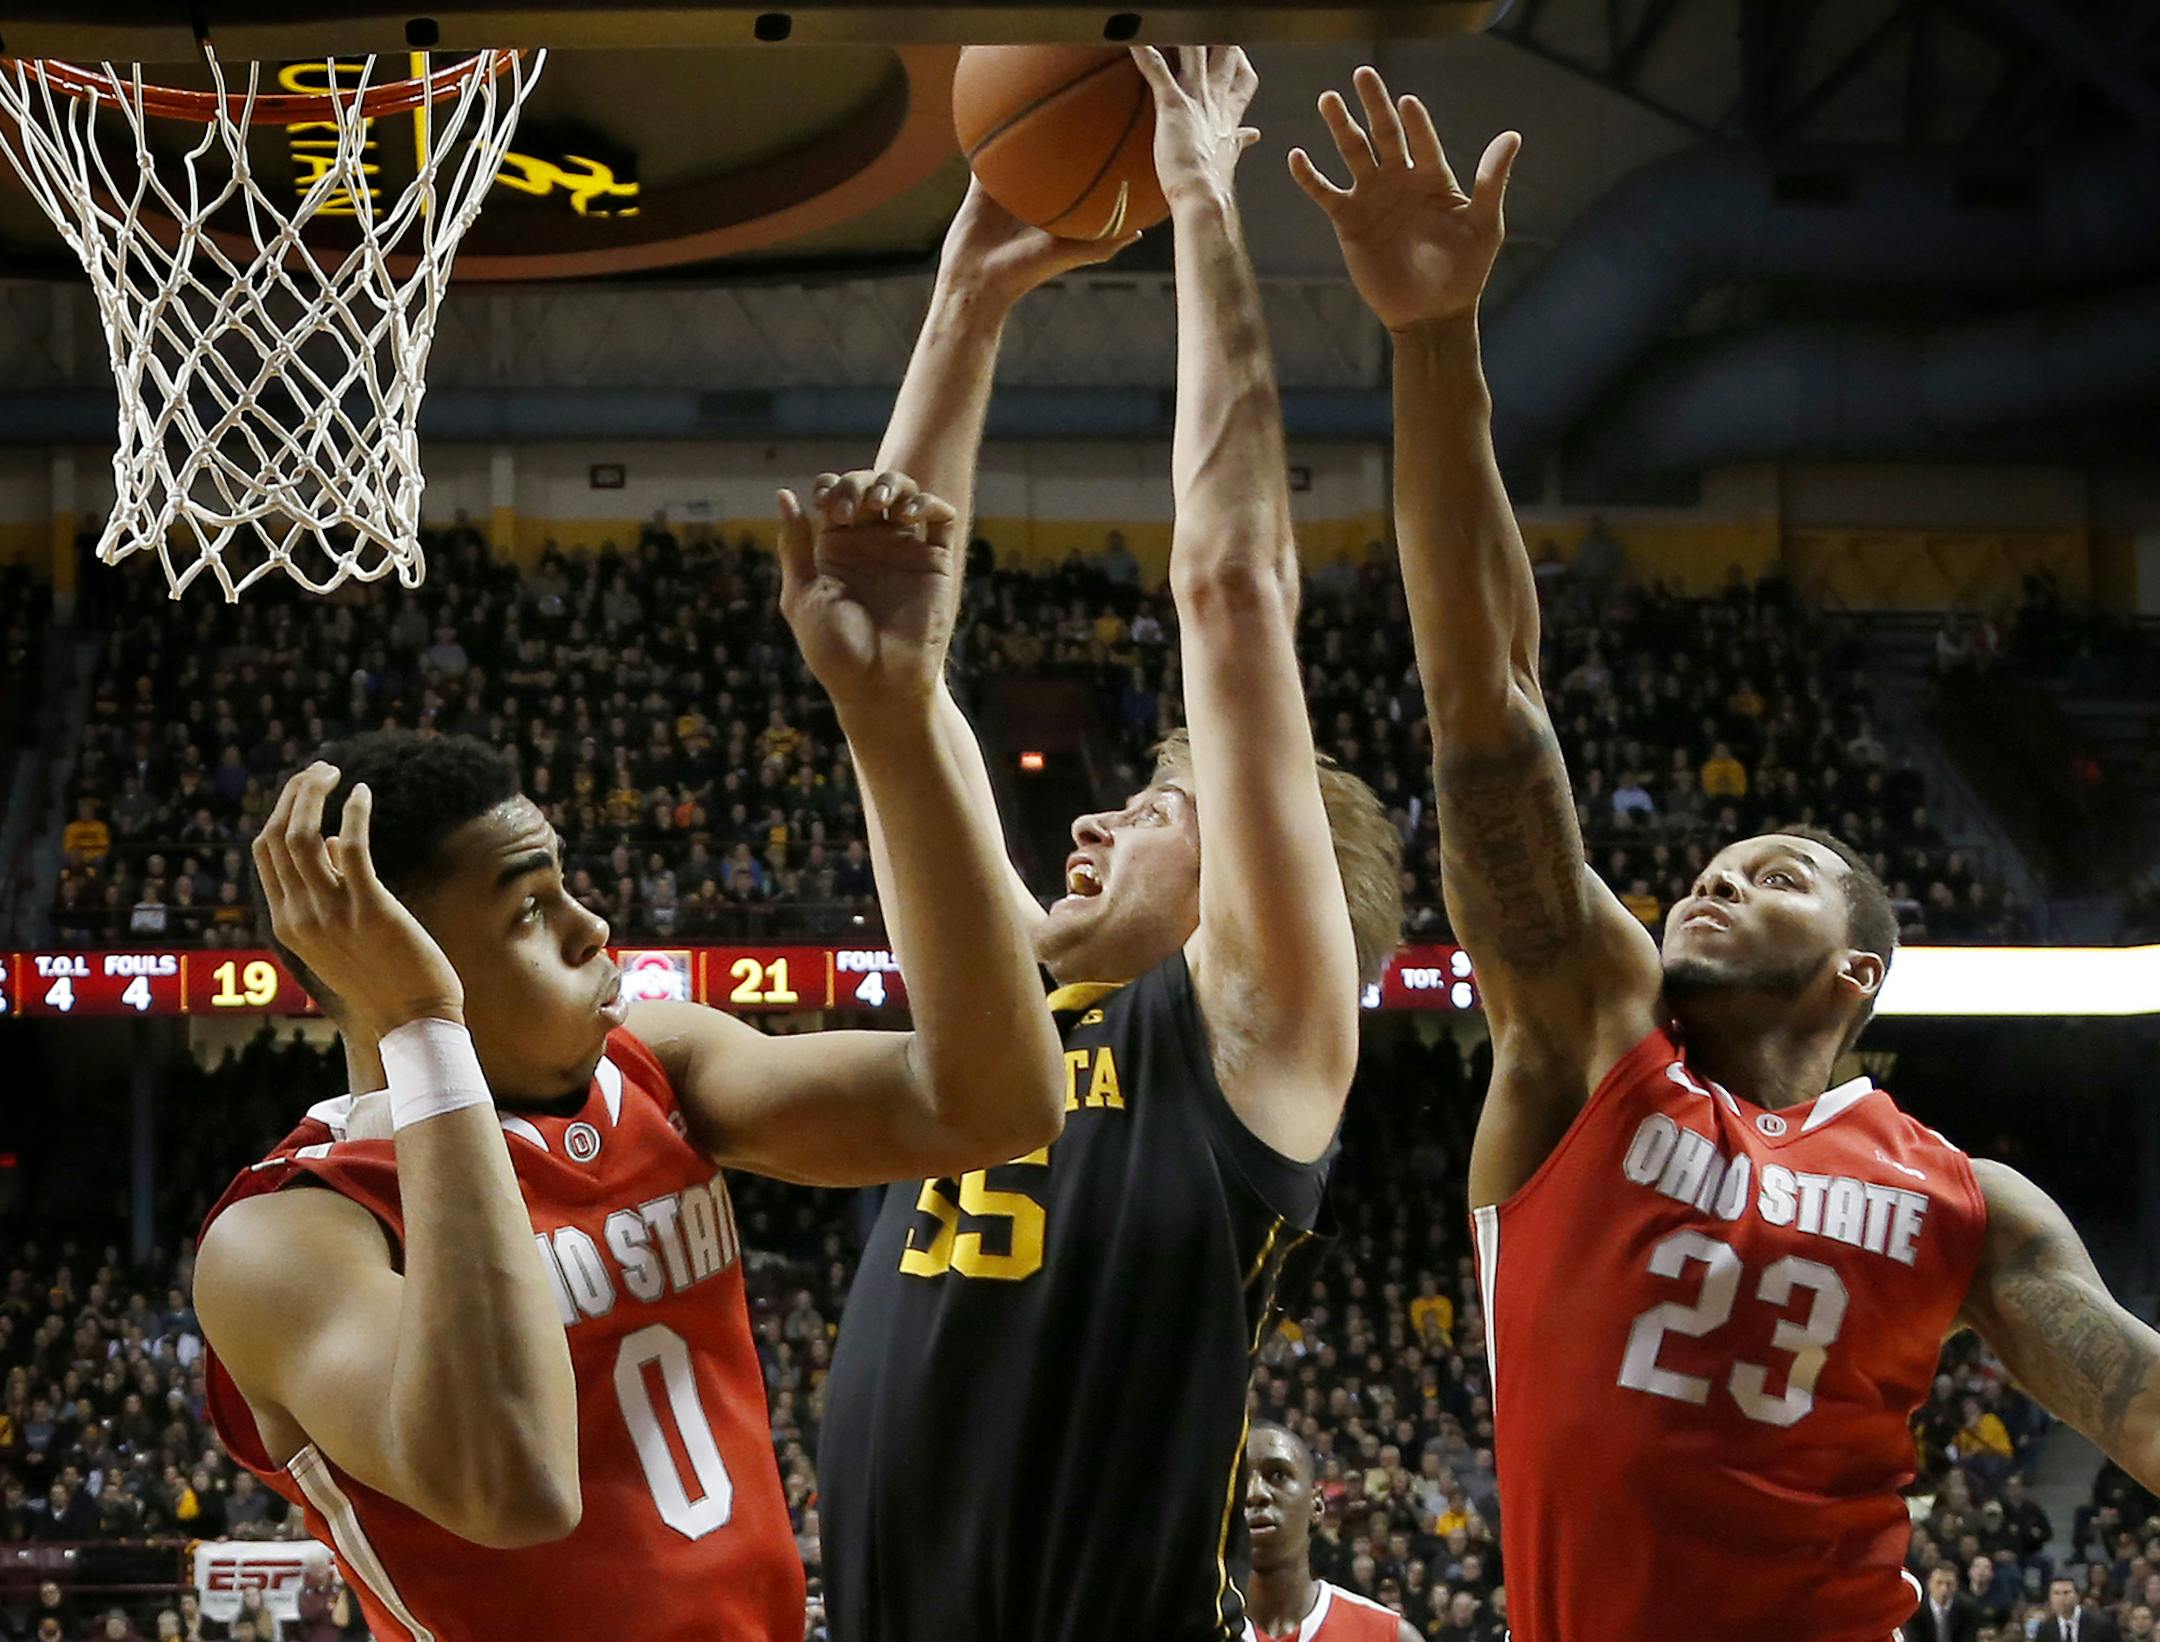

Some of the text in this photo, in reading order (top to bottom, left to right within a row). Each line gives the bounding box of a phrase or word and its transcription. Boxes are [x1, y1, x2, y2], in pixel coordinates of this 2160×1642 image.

[104, 955, 177, 976] FOULS
[211, 961, 278, 1007] 19
[730, 957, 798, 1004] 21
[1400, 968, 1444, 989] TOT.
[45, 976, 75, 1012] 4
[122, 976, 152, 1011] 4
[855, 971, 886, 1007] 4
[1065, 1047, 1126, 1113] TA
[1622, 1112, 1929, 1268] OHIO STATE
[534, 1225, 616, 1327] IO
[1616, 1228, 1849, 1428] 23
[613, 1323, 734, 1541] 0
[207, 1560, 335, 1590] ESP
